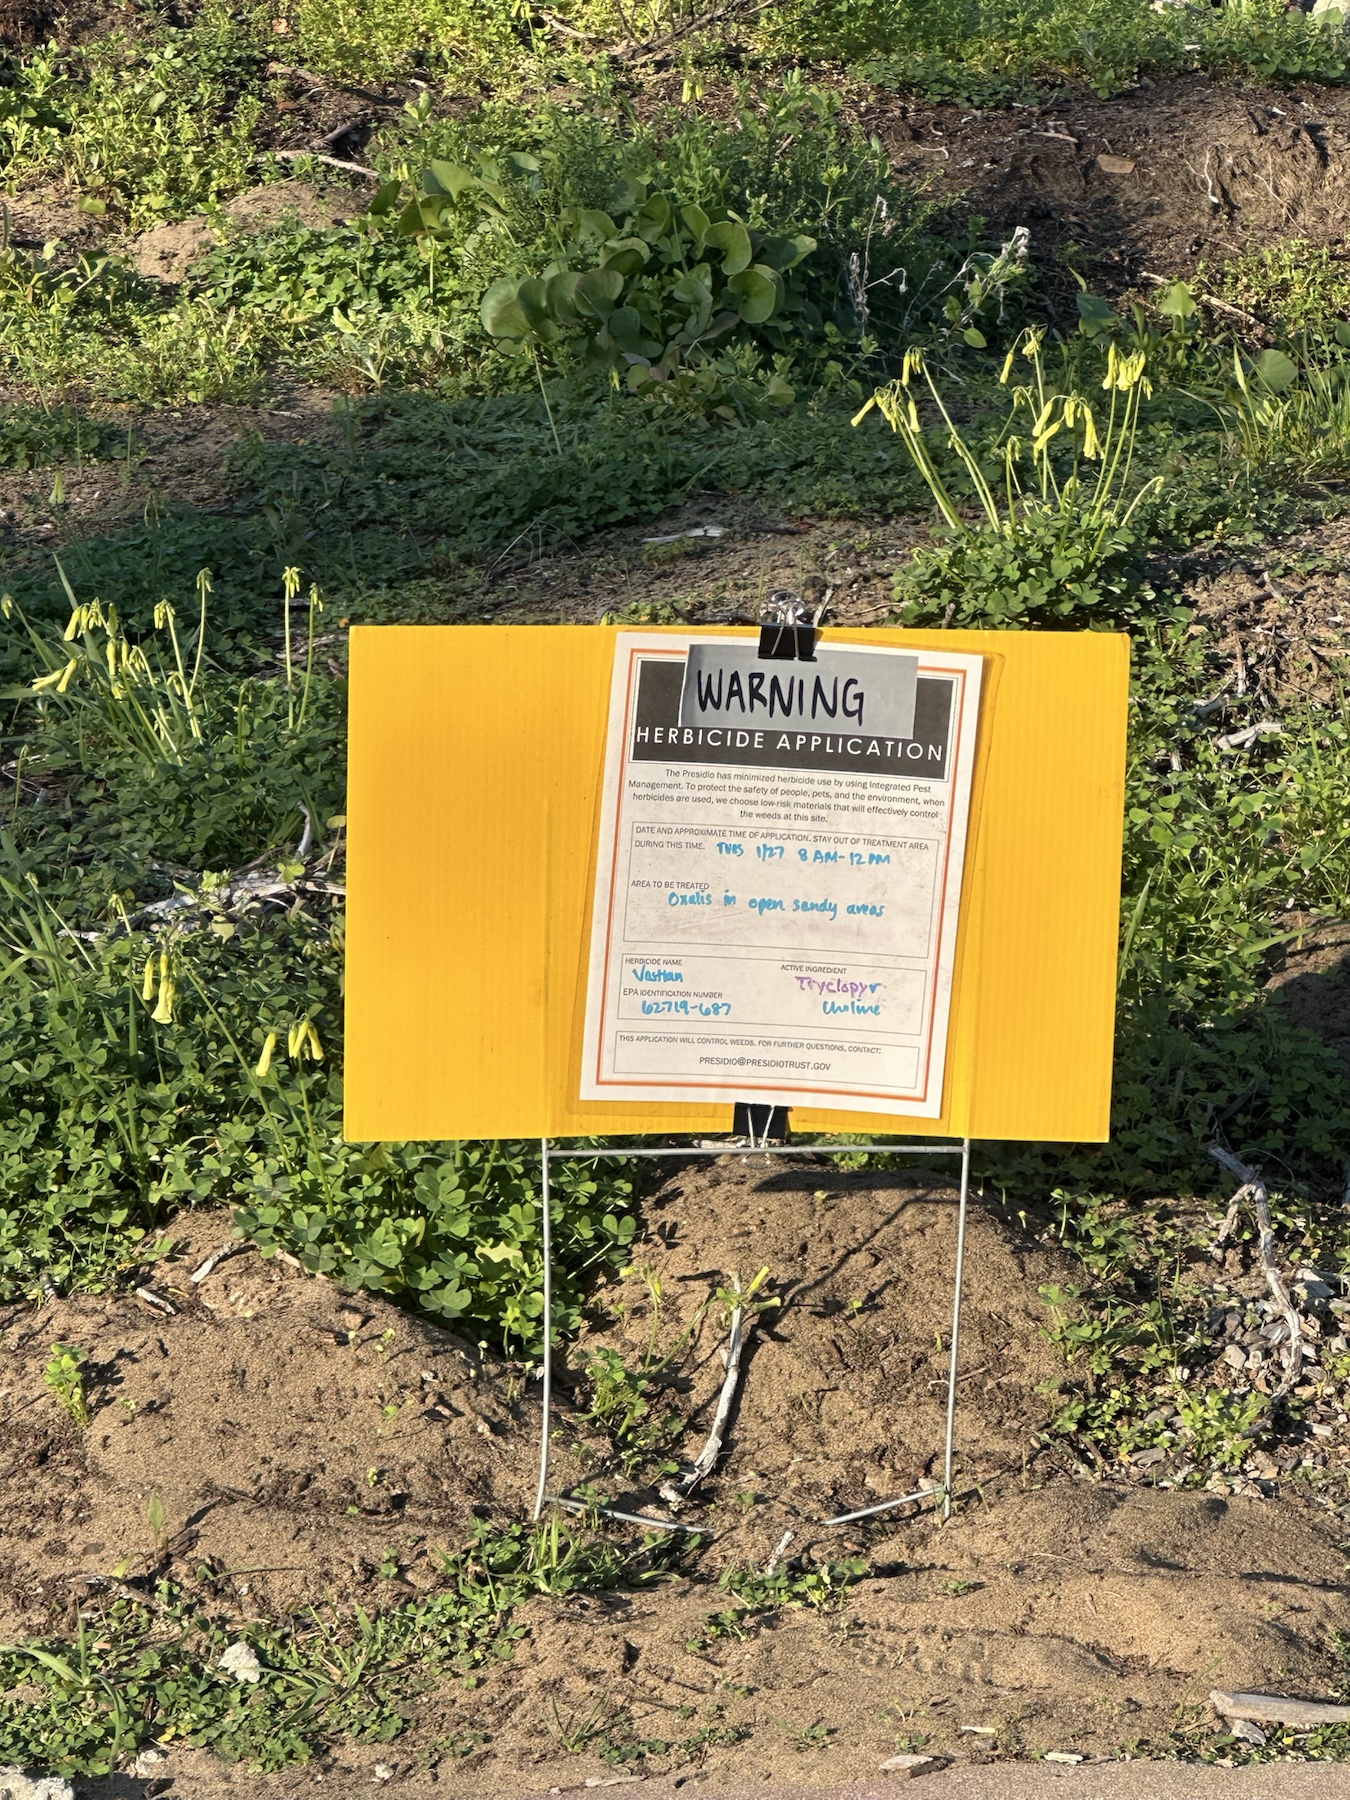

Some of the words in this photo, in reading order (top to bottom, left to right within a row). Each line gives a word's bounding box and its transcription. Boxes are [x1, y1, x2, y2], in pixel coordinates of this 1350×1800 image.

[697, 668, 865, 727] WARNING
[636, 726, 765, 749] HERBICIDE
[776, 733, 943, 761] APPLICATION
[666, 769, 681, 778] The
[682, 770, 715, 779] Presidio
[717, 772, 732, 780] has
[733, 772, 775, 783] minimized
[777, 775, 815, 785] herbicide
[817, 778, 832, 786] use
[834, 778, 844, 788] by
[845, 780, 868, 790] using
[869, 781, 911, 792] Integrated
[913, 784, 932, 794] Pest
[628, 780, 684, 790] Management.
[686, 782, 696, 790] To
[697, 783, 726, 793] protect
[728, 785, 742, 793] the
[743, 785, 768, 796] safety
[770, 787, 779, 795] of
[780, 788, 811, 798] people,
[812, 790, 833, 799] pets,
[834, 791, 850, 800] and
[852, 793, 866, 801] the
[867, 794, 921, 806] environment,
[923, 798, 945, 807] when
[632, 793, 675, 802] herbicides
[676, 795, 690, 803] are
[691, 796, 714, 804] used,
[729, 797, 759, 806] choose
[760, 799, 792, 808] low-risk
[793, 801, 832, 811] materials
[833, 803, 850, 812] that
[851, 804, 865, 813] will
[866, 806, 908, 817] effectively
[909, 809, 939, 818] control
[740, 810, 754, 818] the
[755, 811, 782, 820] weeds
[783, 812, 792, 821] at
[794, 813, 809, 822] this
[810, 814, 828, 823] site.
[634, 840, 664, 849] DURING
[666, 841, 683, 849] THIS
[685, 841, 705, 851] TIME.
[635, 826, 655, 834] DATE
[656, 827, 673, 835] AND
[674, 828, 727, 837] APPROXIMATE
[729, 830, 747, 839] TIME
[748, 831, 759, 839] OF
[813, 835, 833, 843] STAY
[833, 836, 849, 845] OUT
[850, 837, 861, 845] OF
[862, 838, 908, 849] TREATMENT
[909, 842, 929, 851] AREA
[756, 843, 785, 862] 1/27
[798, 848, 808, 862] 8
[868, 852, 891, 865] PM
[630, 880, 650, 888] AREA
[652, 880, 663, 889] TO
[664, 880, 675, 889] BE
[676, 881, 710, 890] TREATED
[668, 889, 713, 907] Oxalis
[723, 889, 737, 907] in
[748, 897, 785, 916] open
[792, 898, 838, 921] sandy
[846, 903, 886, 917] areas
[625, 957, 661, 965] HERBICIDE
[780, 964, 804, 973] ACTIVE
[805, 966, 847, 975] INGREDIENT
[623, 988, 639, 996] EPA
[640, 989, 692, 998] IDENTIFICATION
[693, 991, 723, 999] NUMBER
[641, 999, 732, 1016] 62719-687
[635, 1036, 678, 1044] APPLICATION
[696, 1037, 728, 1045] CONTROL
[758, 1039, 772, 1047] FOR
[773, 1040, 805, 1049] FURTHER
[806, 1042, 847, 1053] QUESTIONS,
[848, 1045, 882, 1055] CONTACT:
[699, 1056, 831, 1070] PRESIDIO@PRESIDIOTRUST.GOV
